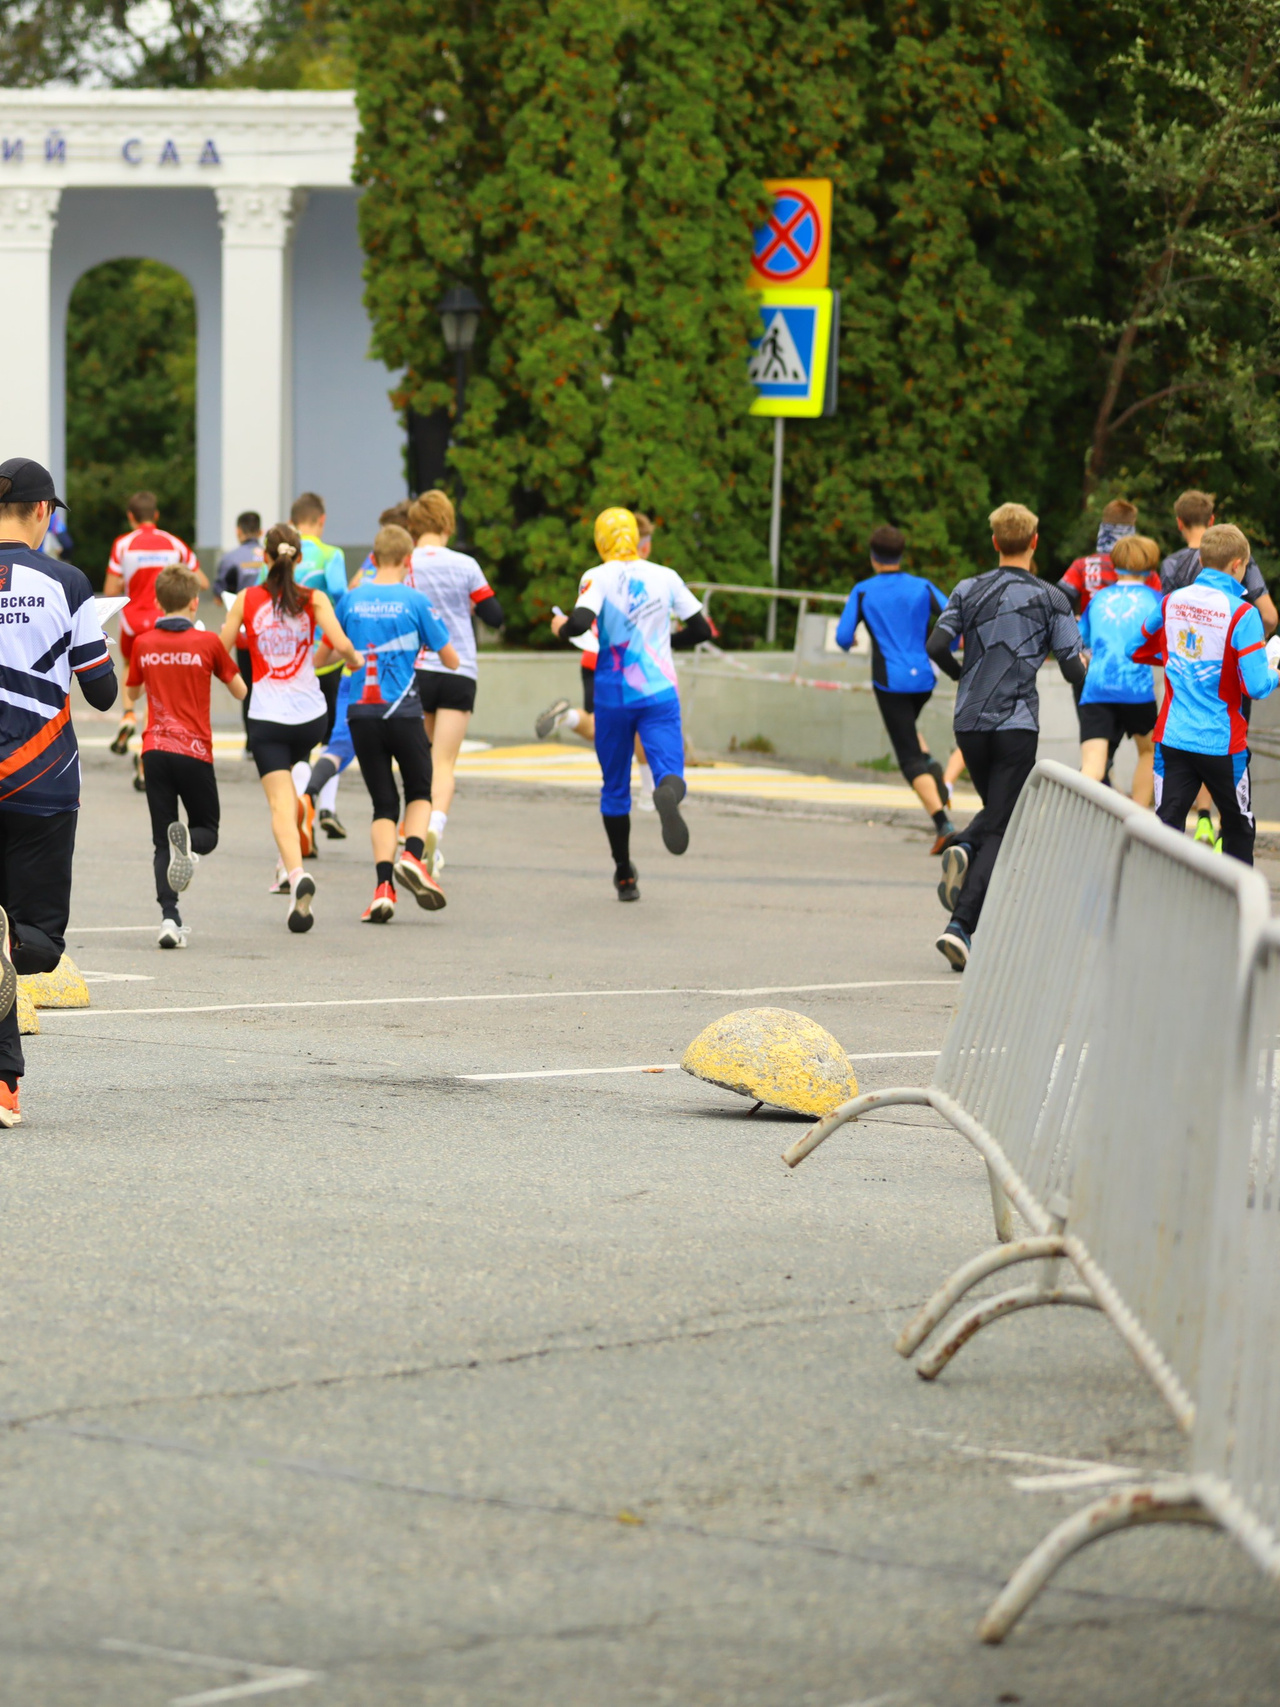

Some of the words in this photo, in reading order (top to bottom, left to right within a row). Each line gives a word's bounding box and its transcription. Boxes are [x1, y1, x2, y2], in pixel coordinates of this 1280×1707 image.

[122, 137, 222, 165] САД
[1169, 603, 1226, 619] ЛЬЯНОВСКАЯ
[1175, 610, 1213, 623] ОБЛАСТЬ
[141, 652, 202, 668] МОСКВА
